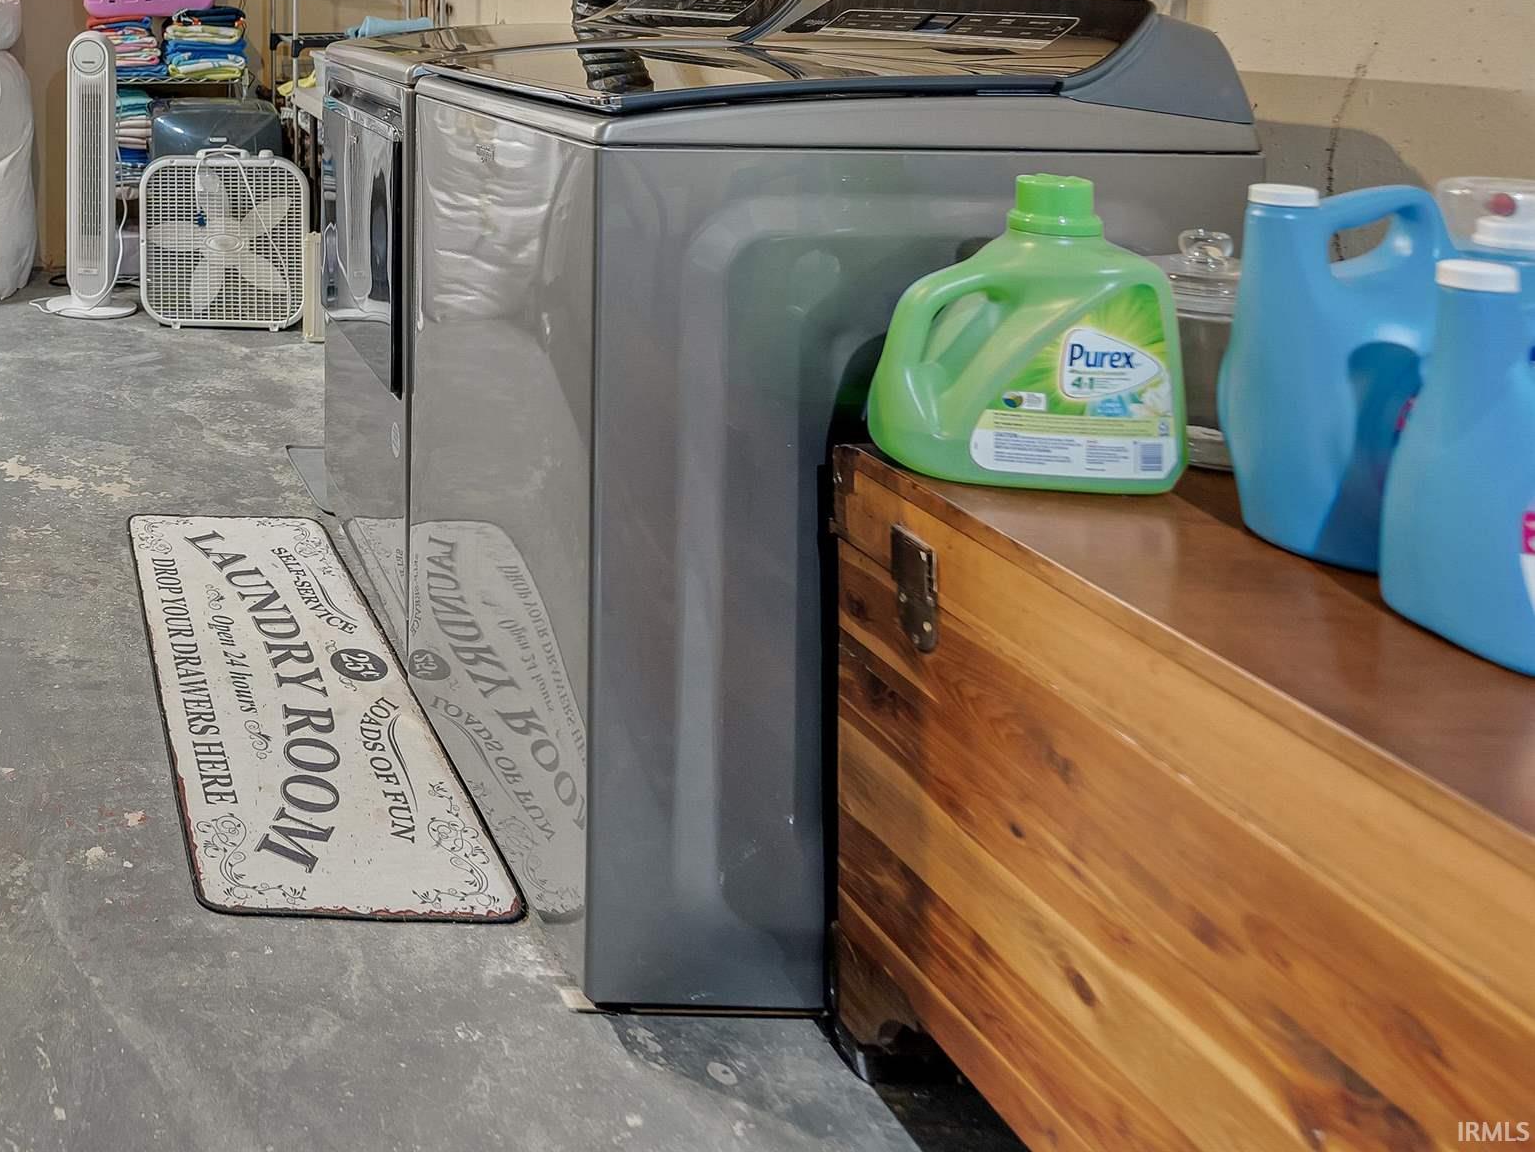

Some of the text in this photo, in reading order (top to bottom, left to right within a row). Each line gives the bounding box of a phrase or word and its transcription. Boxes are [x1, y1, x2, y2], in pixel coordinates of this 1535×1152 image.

[1068, 343, 1136, 369] Purex
[271, 547, 358, 634] SELF-SERVICE
[151, 558, 238, 805] DROP YOUR DRAWERS HERE
[184, 530, 341, 873] LAUNDRY ROOM
[207, 615, 259, 715] Open 24 hours
[360, 697, 416, 844] LOADS OF FUN
